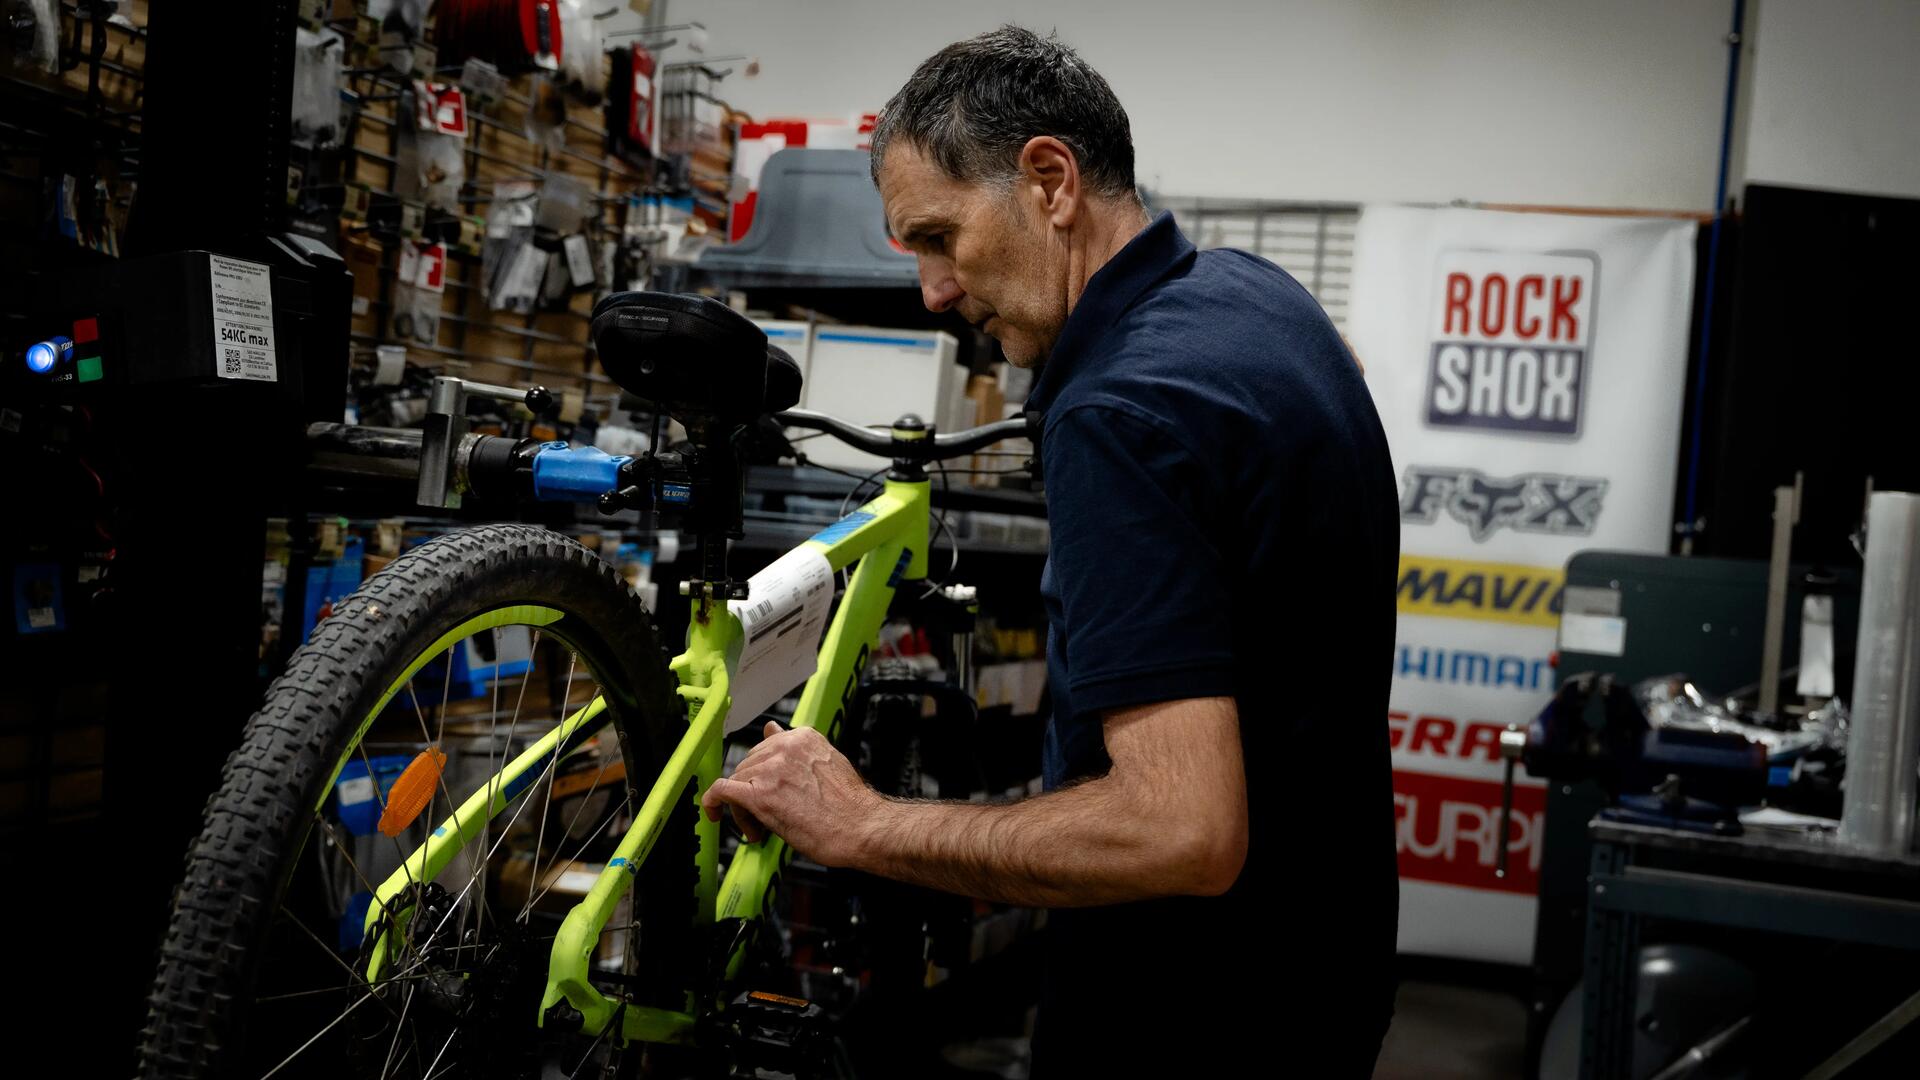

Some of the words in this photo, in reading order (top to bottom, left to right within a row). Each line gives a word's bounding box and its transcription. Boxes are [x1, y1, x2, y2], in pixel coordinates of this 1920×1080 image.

[221, 327, 246, 344] 54KG
[248, 334, 269, 347] max
[1443, 272, 1583, 341] ROCK
[1433, 345, 1579, 421] SHOX
[1398, 464, 1609, 543] FOX
[1396, 644, 1558, 691] HIMAN
[1388, 711, 1527, 765] RA
